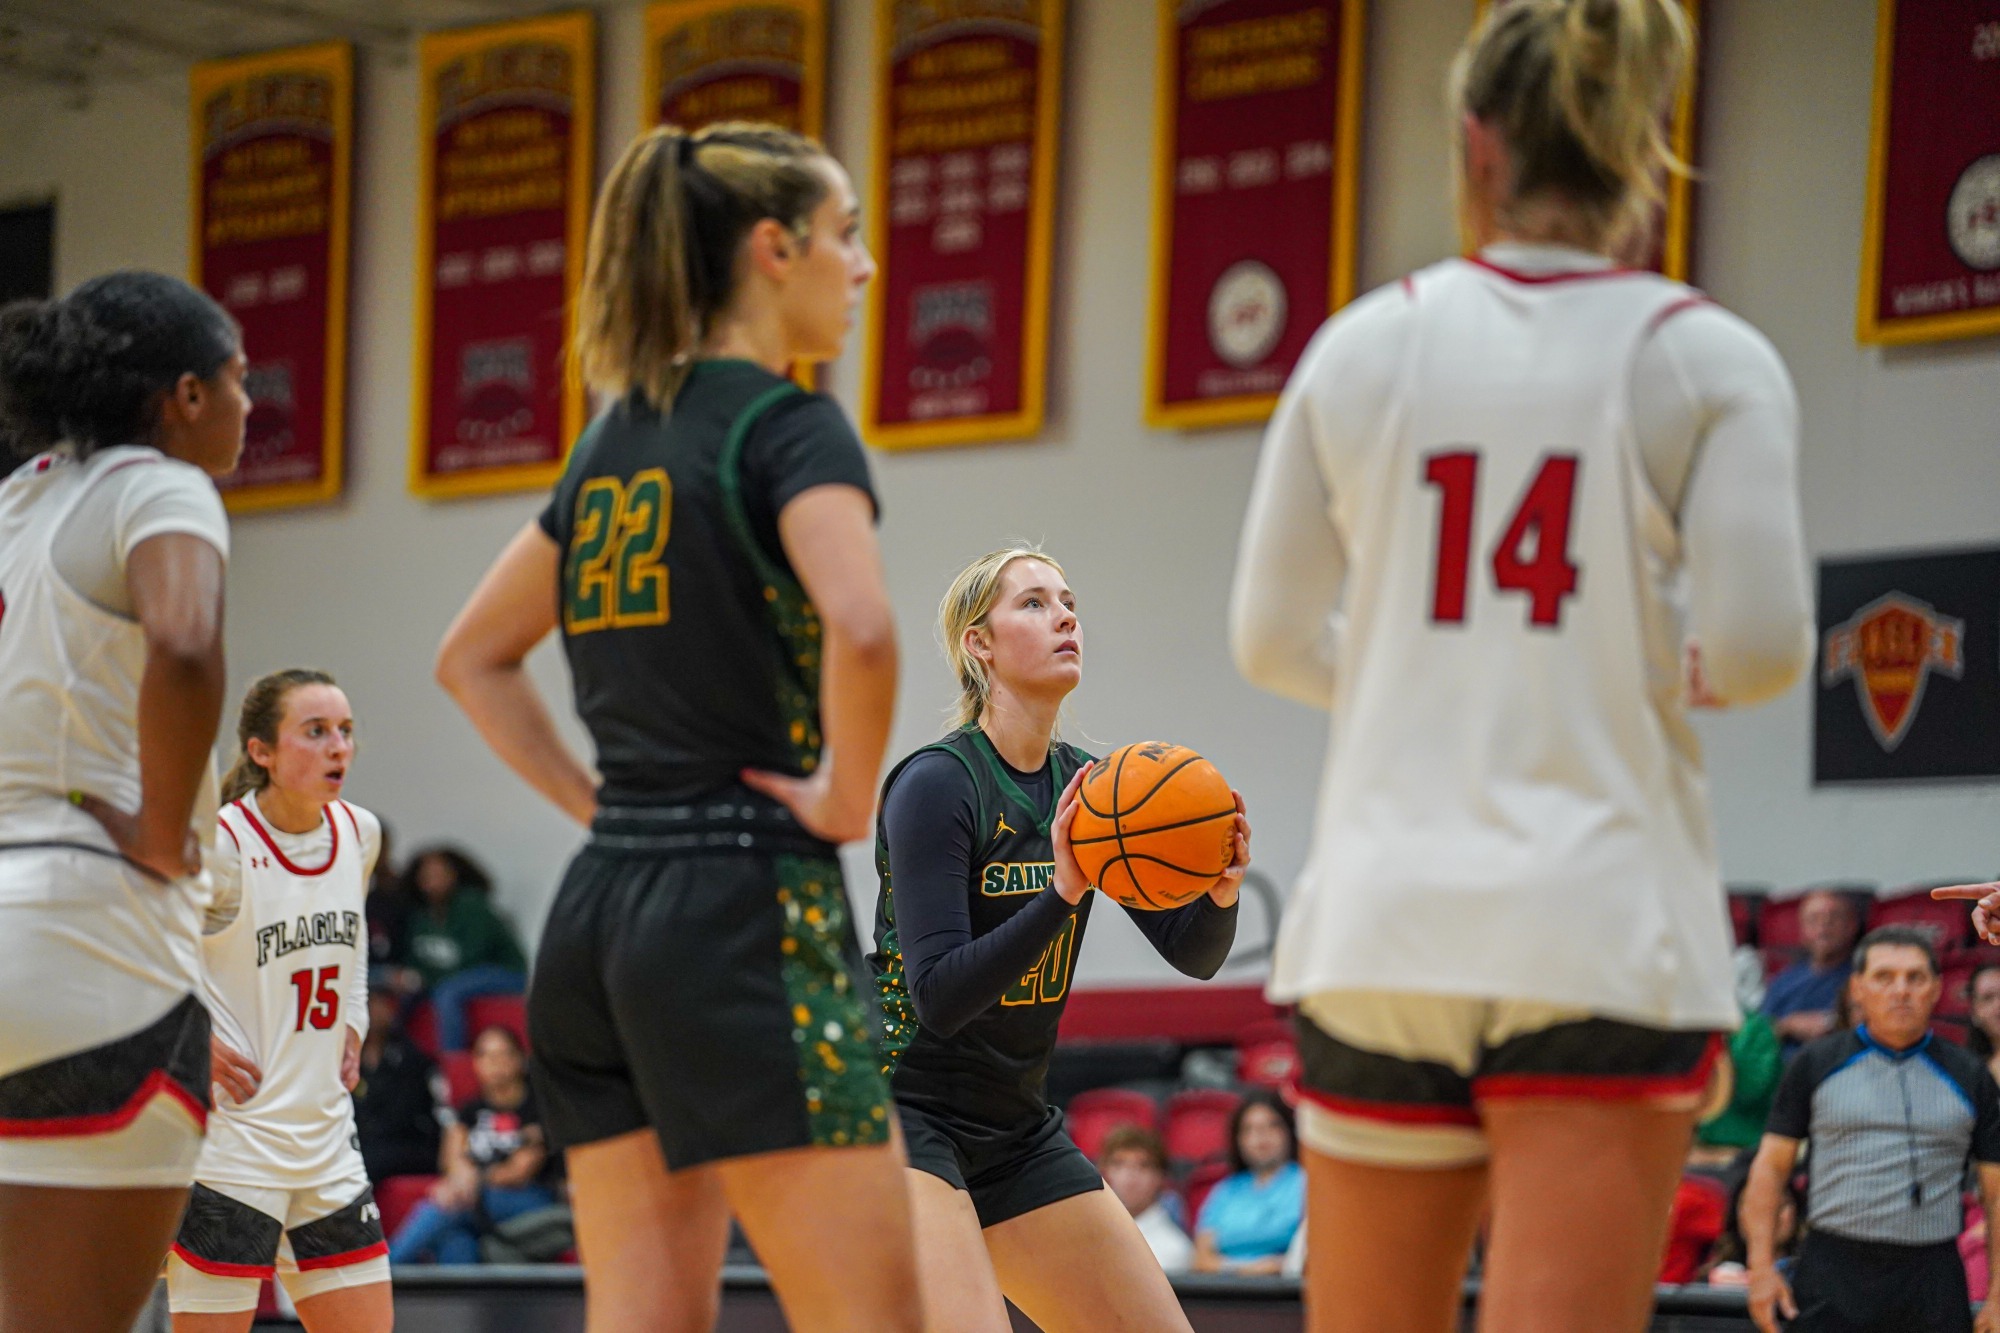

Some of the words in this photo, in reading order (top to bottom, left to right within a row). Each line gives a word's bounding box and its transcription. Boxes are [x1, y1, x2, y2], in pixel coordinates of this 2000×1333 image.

[564, 467, 672, 635] 22
[1422, 449, 1579, 630] 14
[256, 910, 359, 967] FLAGLE
[291, 964, 340, 1032] 15
